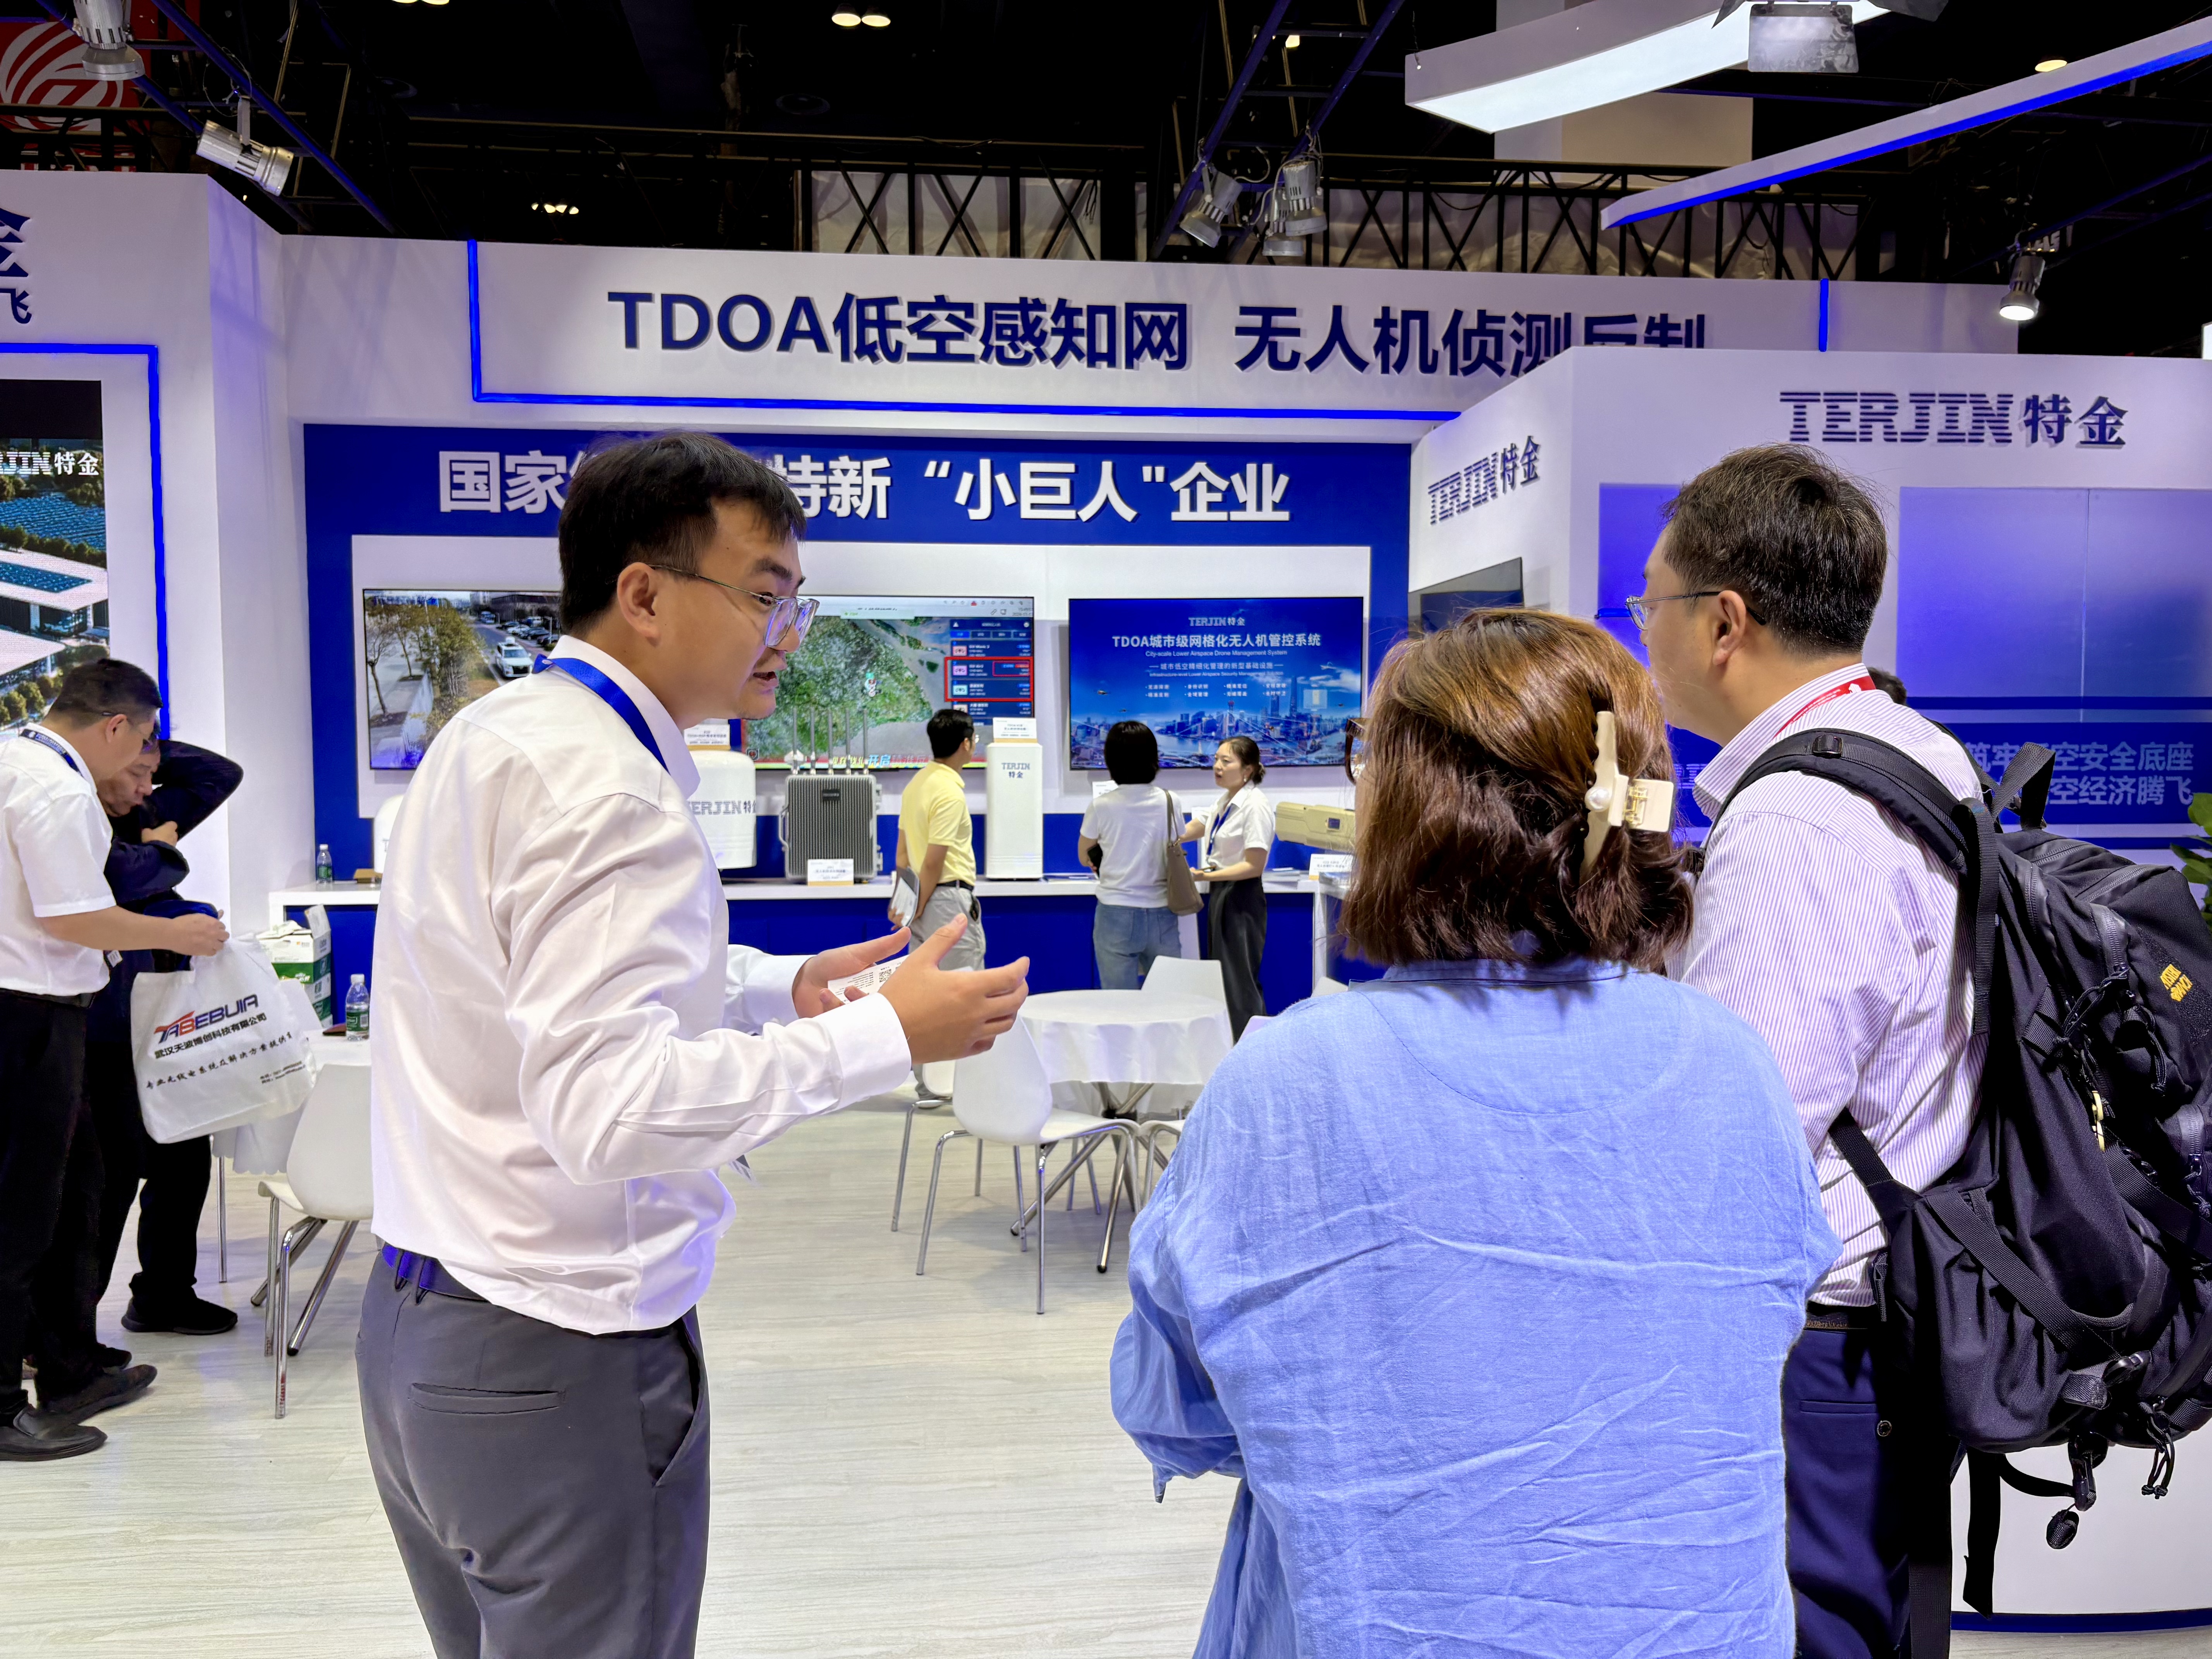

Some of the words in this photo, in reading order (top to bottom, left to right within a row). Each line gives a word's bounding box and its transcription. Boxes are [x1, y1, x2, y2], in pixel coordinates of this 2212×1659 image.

[608, 292, 1188, 370] TDOA低空感知网
[2023, 393, 2129, 445] 特金
[0, 452, 51, 475] JIN
[54, 452, 100, 476] 特金
[1501, 435, 1540, 494] 特金
[439, 449, 891, 520] 国家特新
[1112, 633, 1321, 647] TDOA城市级网格化无人机管控系统
[1966, 741, 2194, 772] 筑牢空安全底座
[2046, 775, 2194, 805] 空经济腾飞
[688, 800, 742, 815] ERJIN
